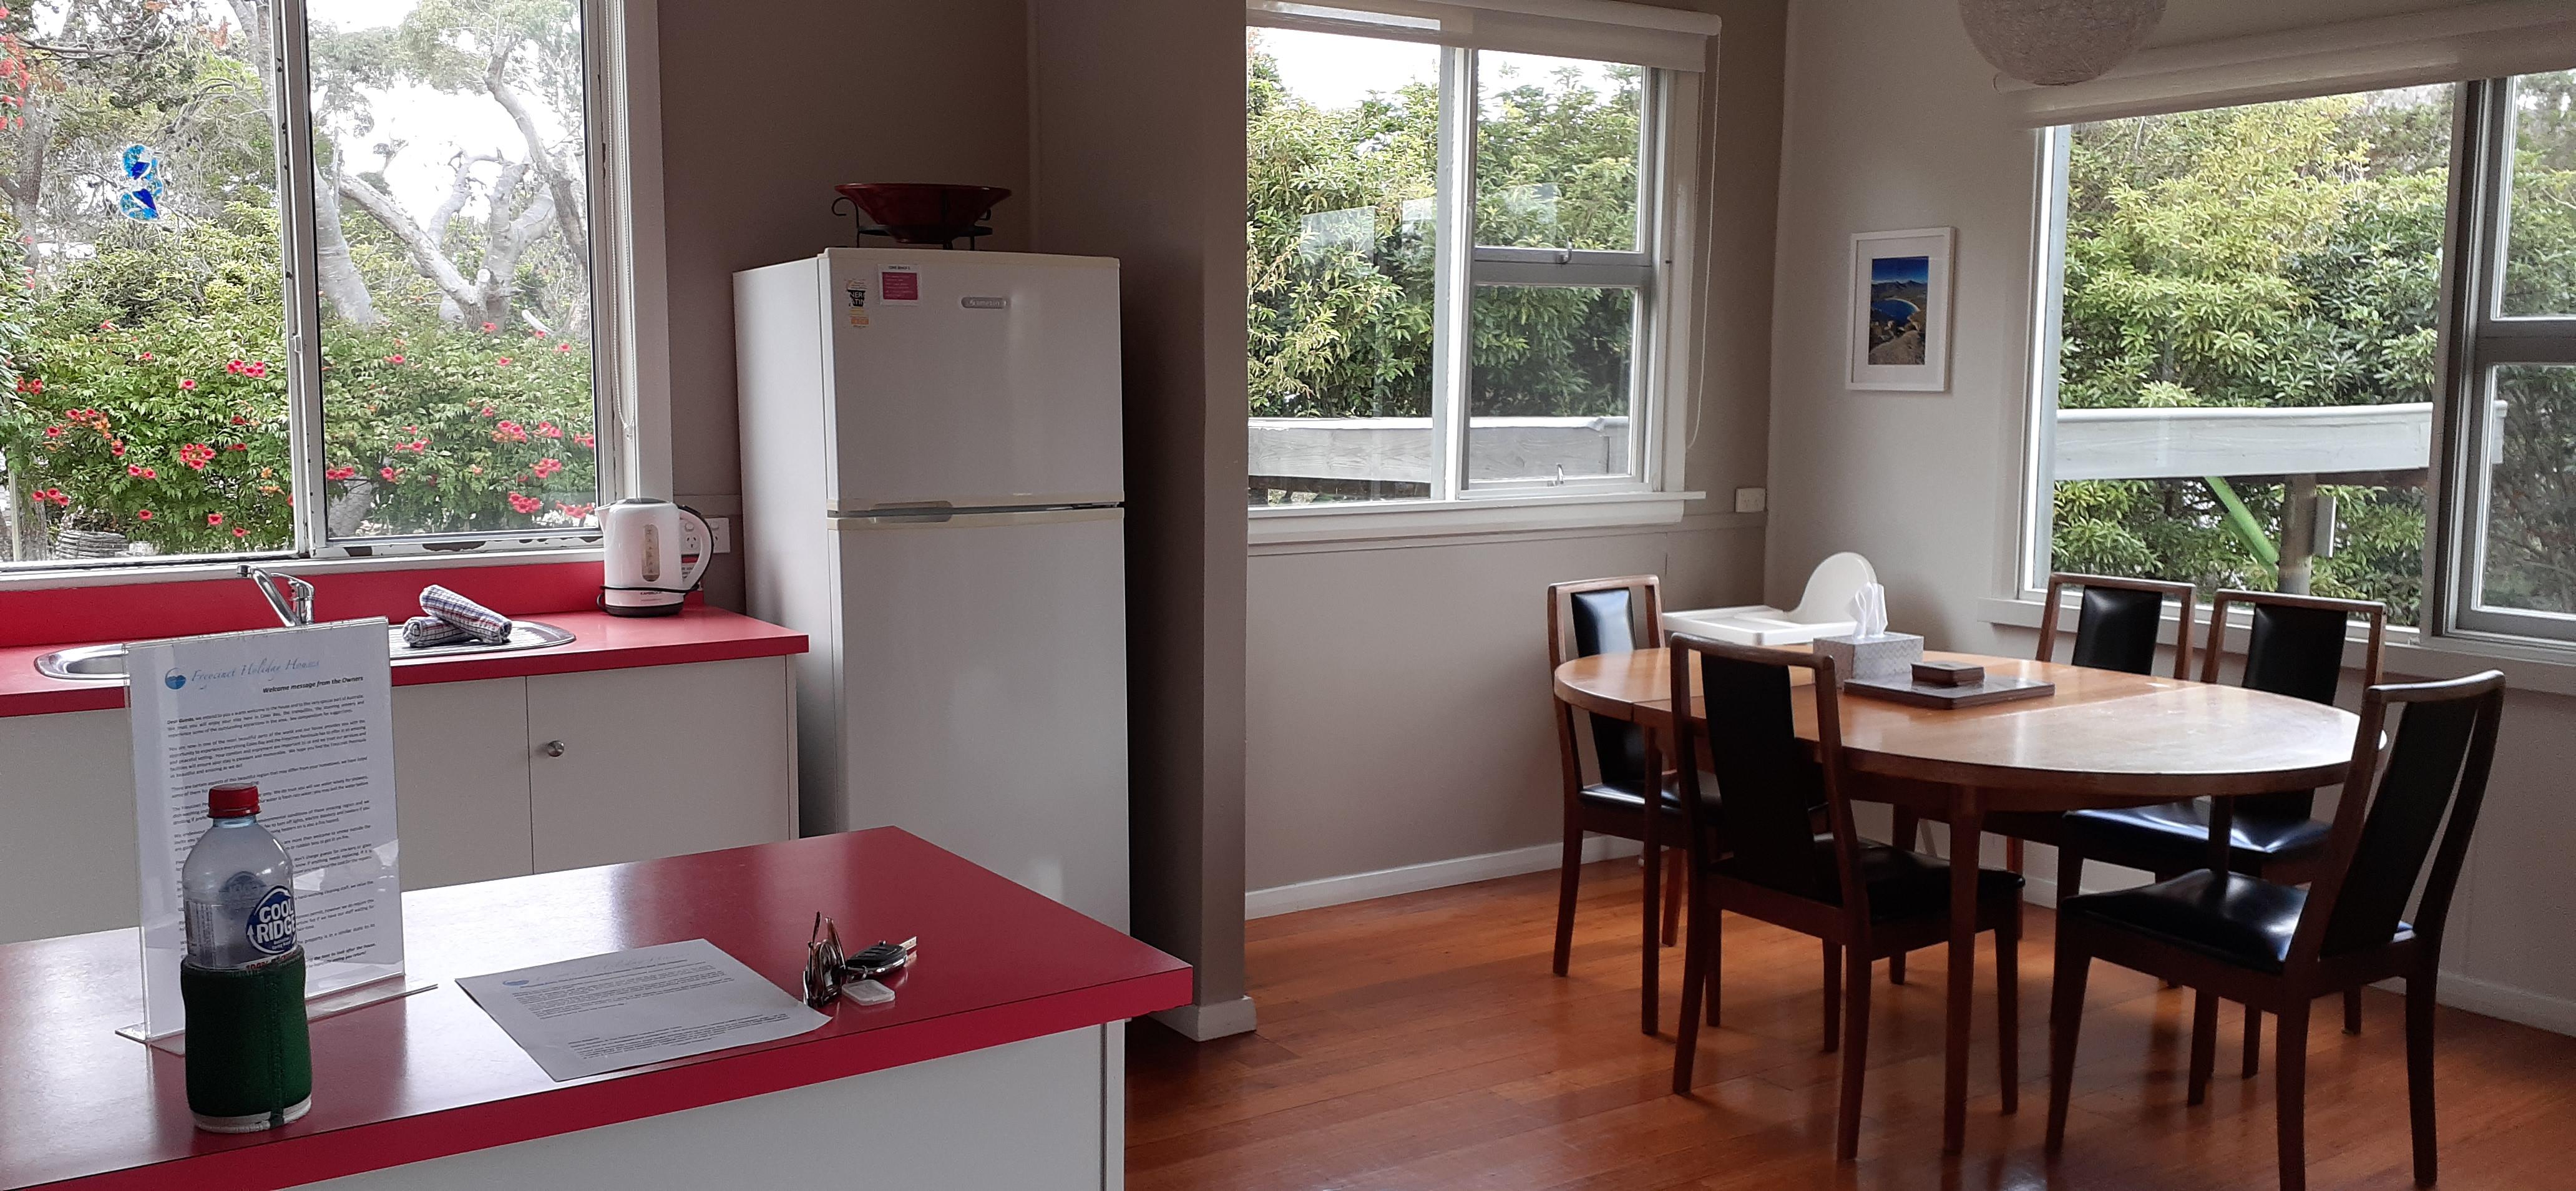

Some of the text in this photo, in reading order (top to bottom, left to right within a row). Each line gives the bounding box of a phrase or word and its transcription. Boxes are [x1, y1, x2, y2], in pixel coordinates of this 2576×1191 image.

[263, 685, 290, 694] Welcome
[291, 682, 316, 691] message
[316, 680, 331, 689] from
[259, 898, 294, 923] COOL
[256, 914, 296, 943] RIDGE
